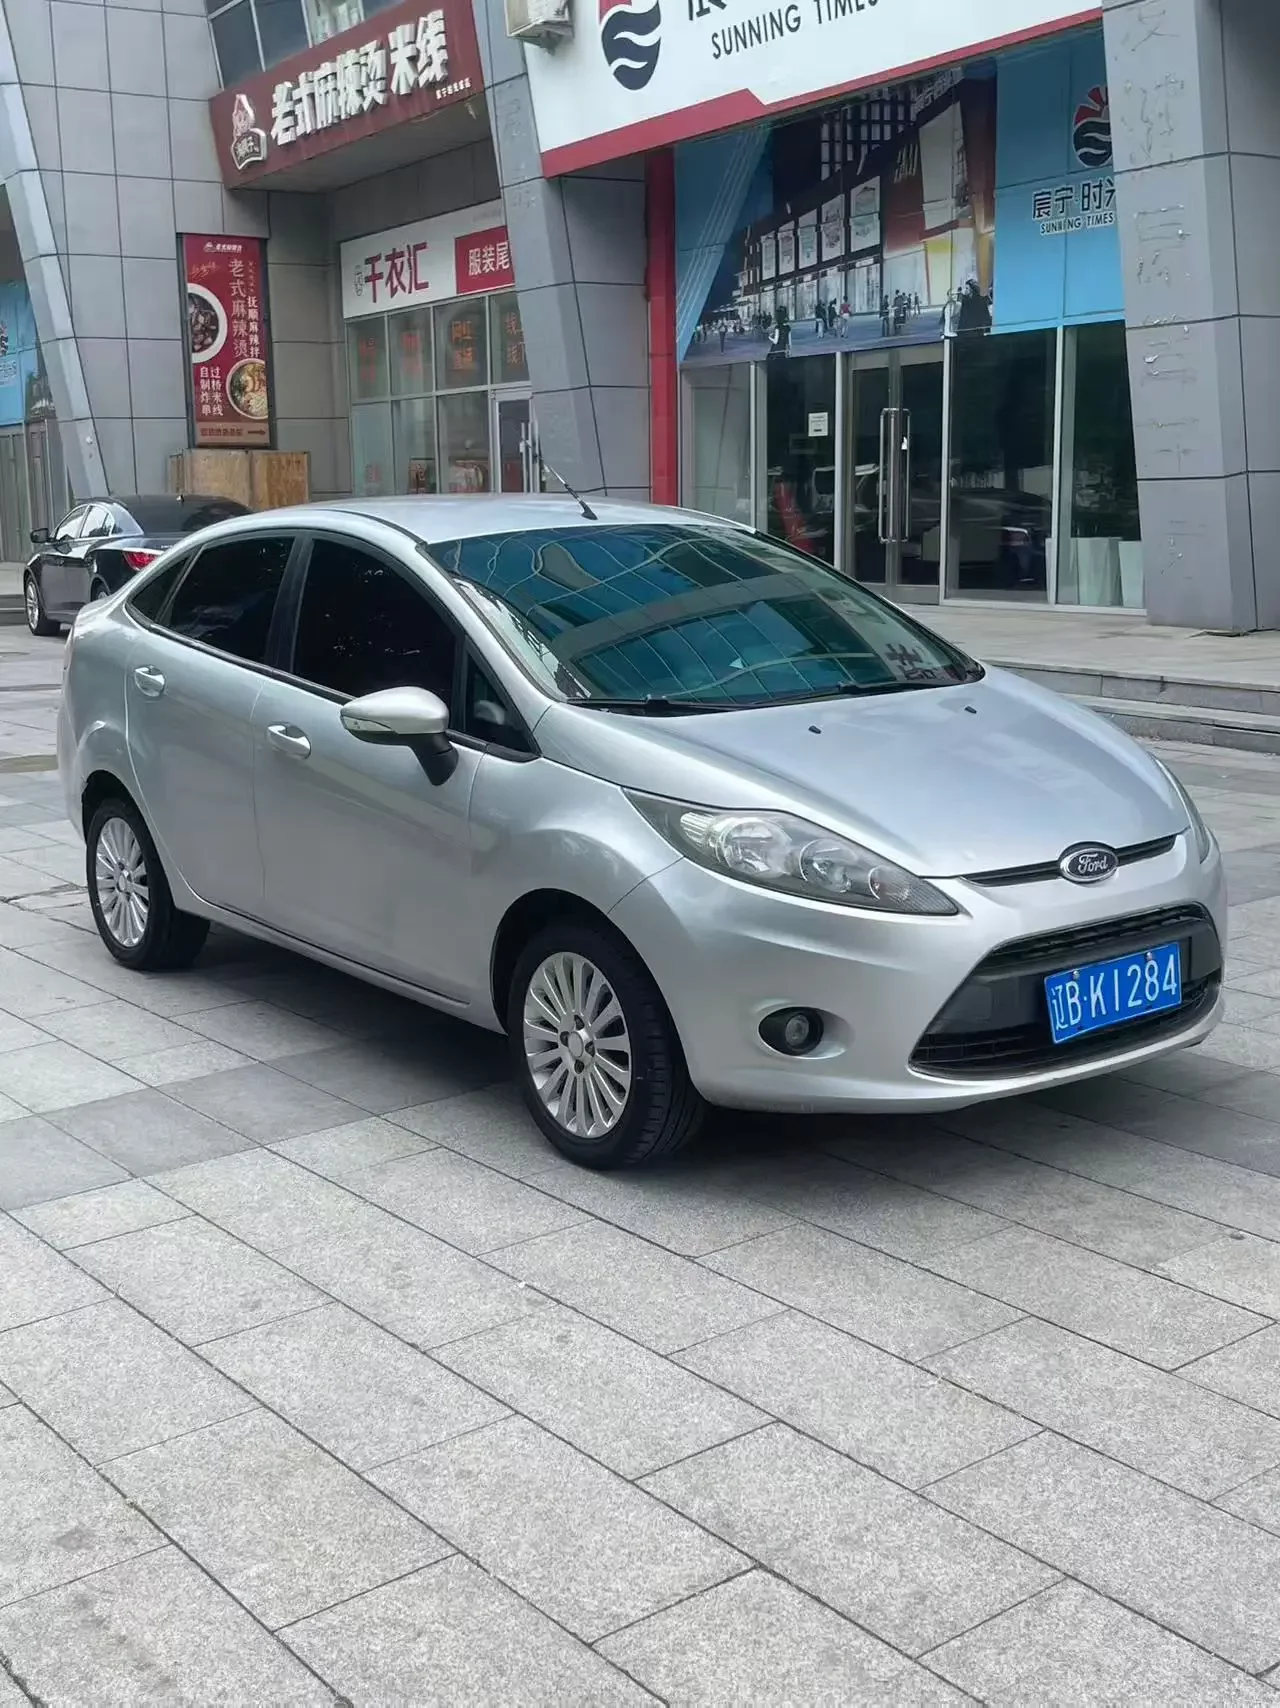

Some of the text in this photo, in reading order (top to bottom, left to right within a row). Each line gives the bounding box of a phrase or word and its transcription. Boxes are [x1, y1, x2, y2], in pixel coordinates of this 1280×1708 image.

[711, 4, 801, 59] SUNNING
[813, 0, 878, 24] TIM
[270, 40, 388, 146] 老式麻辣烫
[1041, 211, 1114, 234] SUNNING TIMES
[364, 241, 430, 304] 千衣汇
[468, 241, 511, 276] 服装尾
[228, 258, 248, 358] 老式麻辣烫
[200, 366, 211, 416] 自制炸串
[210, 366, 224, 416] 过桥米线
[1077, 853, 1109, 874] Ford
